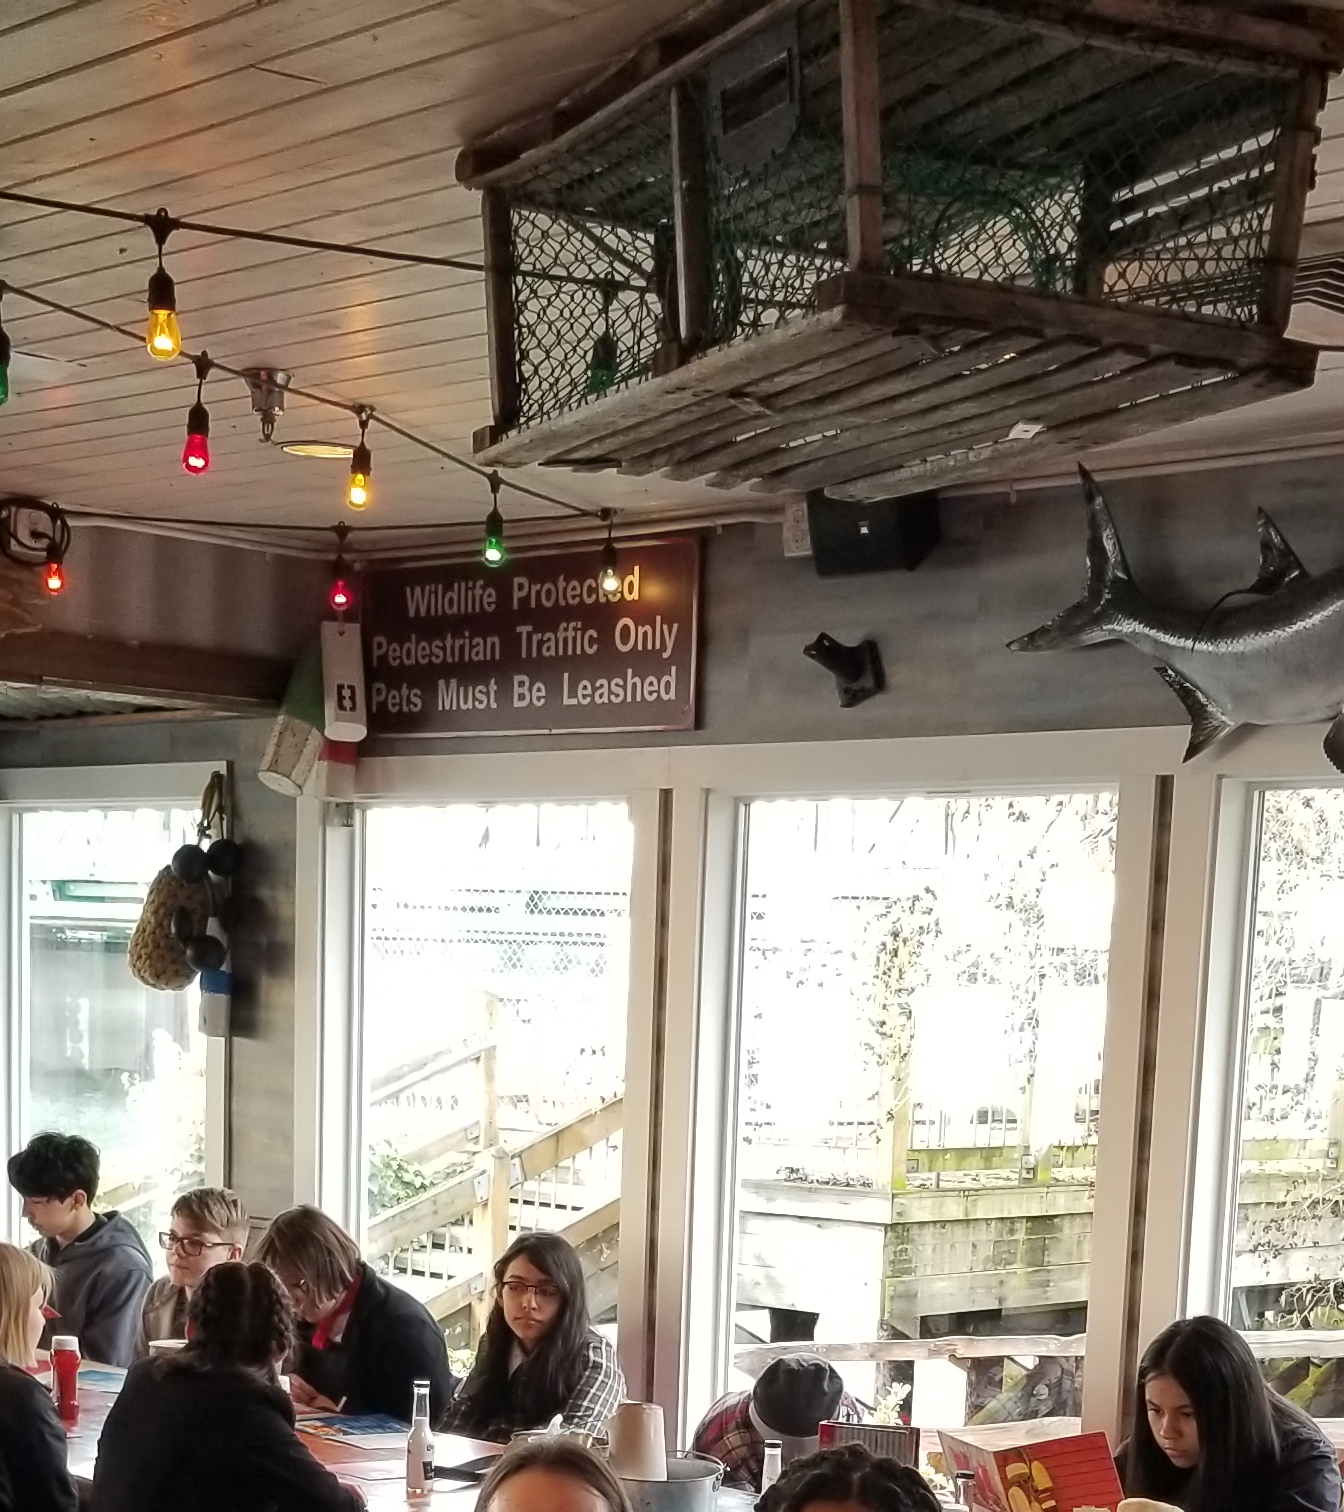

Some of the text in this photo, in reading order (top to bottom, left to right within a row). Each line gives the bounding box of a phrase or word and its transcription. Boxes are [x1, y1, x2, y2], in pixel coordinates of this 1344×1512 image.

[406, 565, 641, 618] Wildlife Protected
[372, 615, 679, 667] Pedestrian Traffic Only
[372, 665, 677, 714] Pets Must Be Leashed
